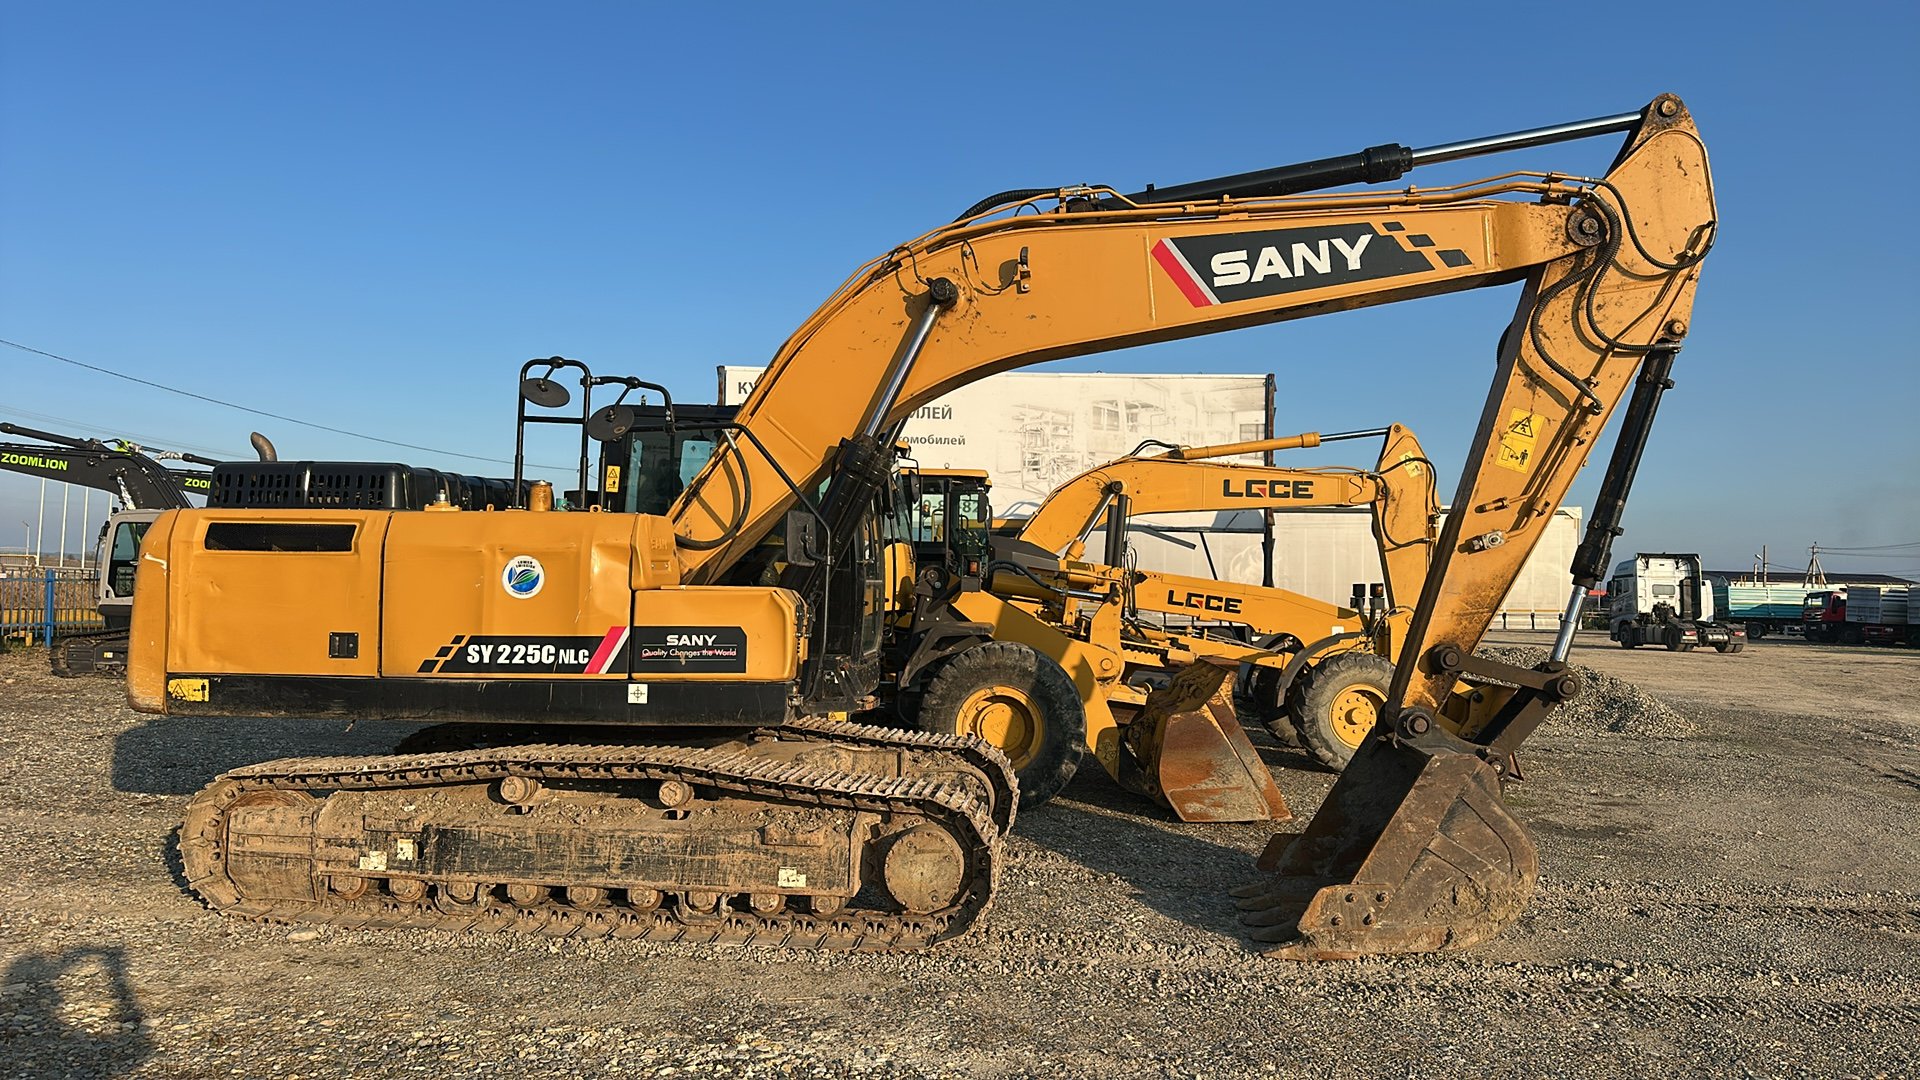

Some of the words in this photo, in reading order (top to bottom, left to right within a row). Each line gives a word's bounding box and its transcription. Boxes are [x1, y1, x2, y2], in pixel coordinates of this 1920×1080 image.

[1210, 234, 1373, 287] SANY
[898, 434, 966, 446] омобилей
[1, 453, 68, 471] ZOOMLION
[1223, 479, 1314, 499] LGCE
[1167, 590, 1243, 614] LGCE
[666, 634, 717, 646] SANY
[466, 644, 494, 664] SY
[496, 644, 556, 665] 225C
[558, 649, 590, 665] NLC
[642, 648, 668, 658] Quality
[669, 648, 701, 658] Changes
[702, 648, 713, 656] the
[715, 648, 737, 656] World
